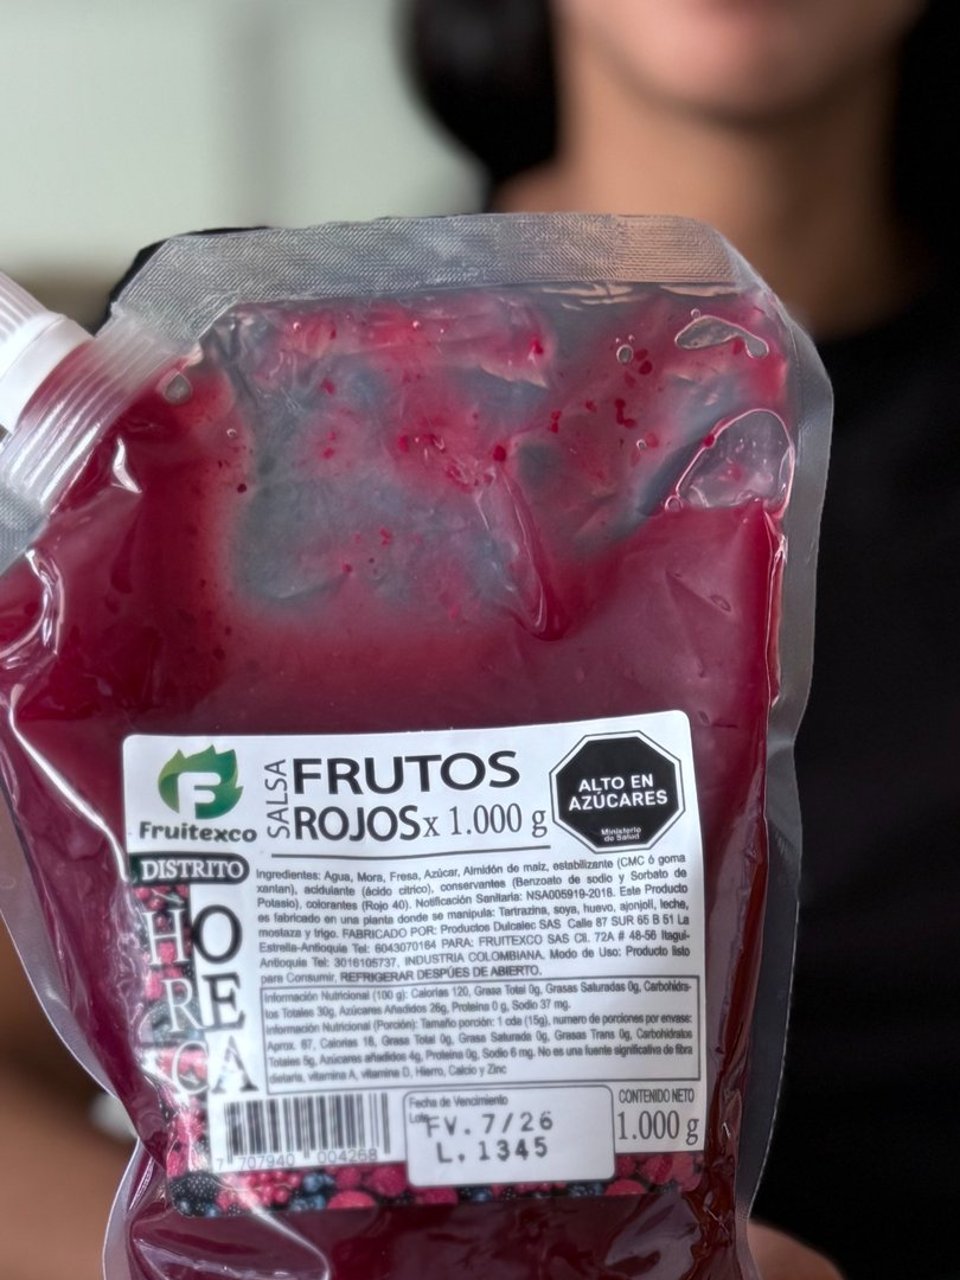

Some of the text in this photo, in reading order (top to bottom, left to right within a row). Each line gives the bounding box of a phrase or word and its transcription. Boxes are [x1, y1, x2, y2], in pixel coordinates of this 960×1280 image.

[293, 750, 520, 795] FRUTOS
[578, 774, 654, 792] ALTO EN
[264, 760, 290, 838] SALSA
[569, 789, 668, 811] AZÚCARES
[140, 821, 257, 843] Fruitexco
[294, 803, 547, 842] ROJOS x 1.000 g
[601, 826, 641, 836] Ministerio
[141, 859, 244, 880] DISTRITO
[256, 869, 320, 880] Ingredientes:
[324, 871, 353, 883] Agua,
[357, 872, 385, 883] Mora,
[390, 871, 421, 881] Fresa,
[424, 867, 460, 879] Azúcar,
[463, 865, 503, 876] Almidón
[507, 863, 519, 873] de
[553, 858, 613, 871] estabilizante
[617, 855, 644, 869] (CMC
[658, 854, 685, 865] goma
[257, 898, 302, 909] Potasio),
[306, 901, 357, 910] colorantes
[362, 900, 388, 911] (Rojo
[392, 899, 412, 911] 40).
[415, 895, 472, 908] Notificación
[476, 894, 522, 904] Sanitaria:
[620, 885, 641, 897] Este
[645, 883, 688, 894] Producto
[259, 957, 307, 969] Antioquia
[312, 957, 329, 967] Tel:
[405, 952, 464, 966] INDUSTRIA
[261, 965, 542, 984] para Consumir, REFRIGERAR DESPÚES DE ABIERTO.
[409, 1094, 508, 1108] Fecha de Vencimiento
[619, 1088, 694, 1103] CONTENIDO NETO
[617, 1110, 699, 1145] 1.000 g
